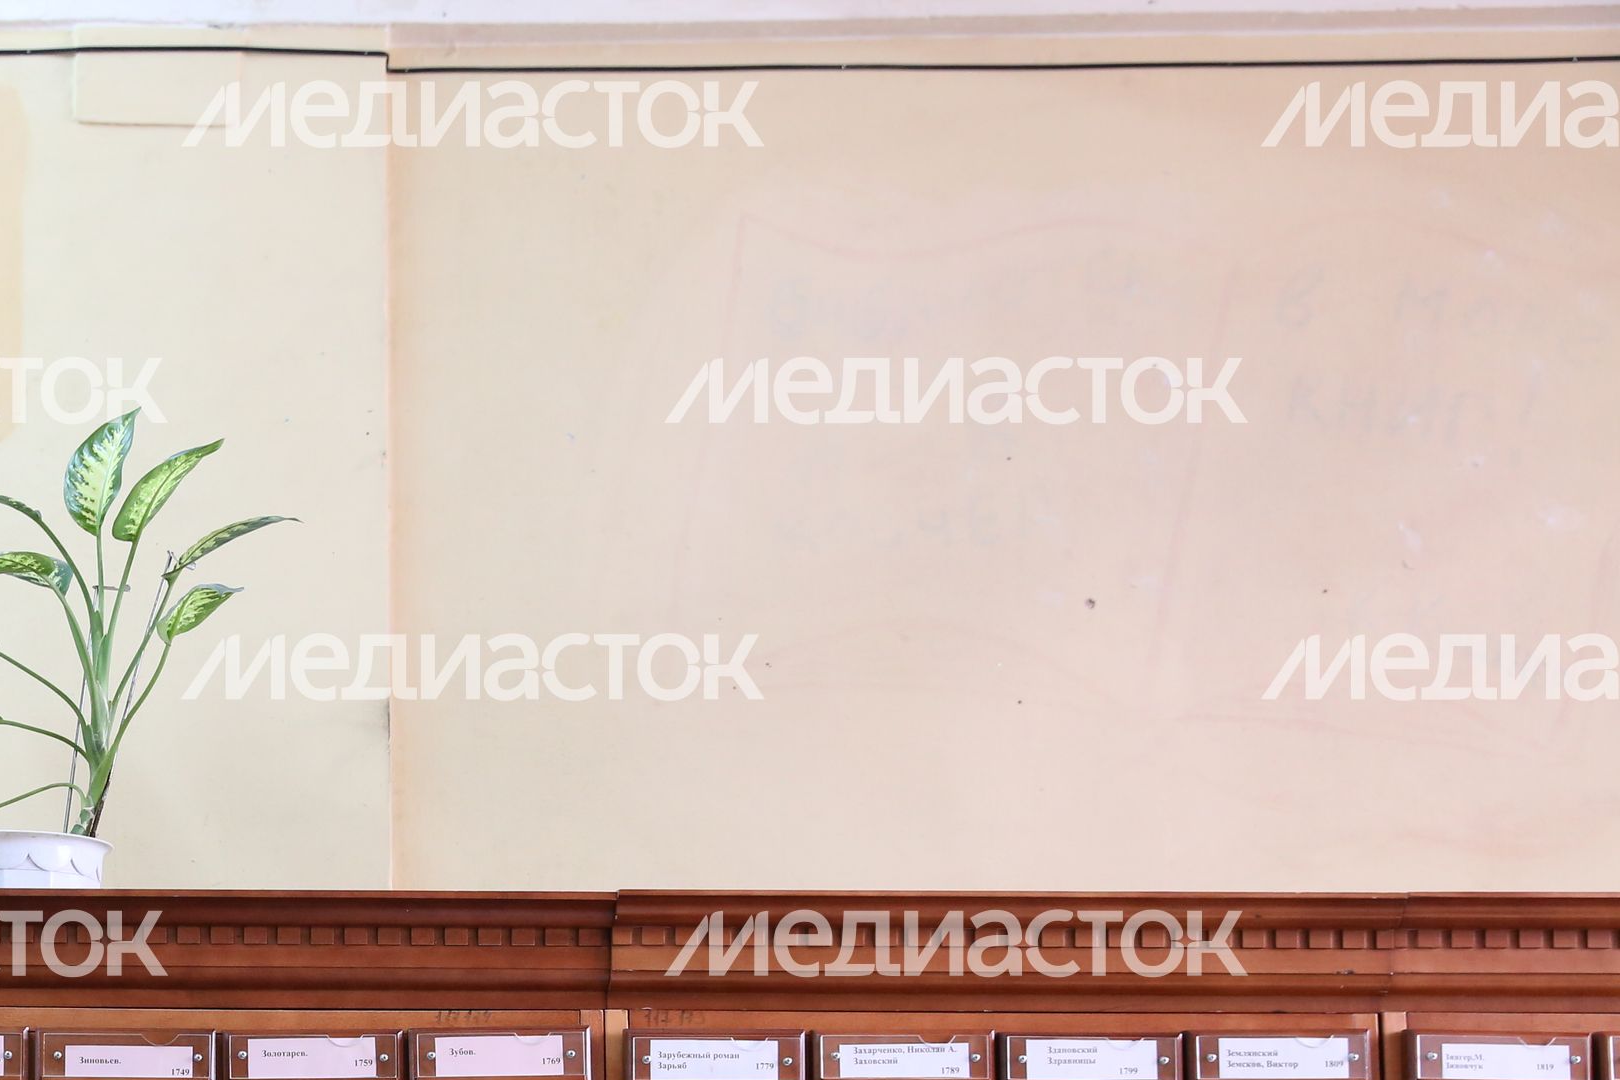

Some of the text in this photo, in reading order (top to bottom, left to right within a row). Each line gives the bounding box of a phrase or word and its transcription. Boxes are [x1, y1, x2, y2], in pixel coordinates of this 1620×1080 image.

[261, 1049, 308, 1059] Золотарев.
[449, 1048, 476, 1057] Зубов.
[658, 1051, 710, 1060] Зарубежный
[854, 1047, 905, 1056] Захарченко,
[79, 1056, 122, 1064] Зиновьев.
[354, 1059, 373, 1067] 1759
[542, 1057, 561, 1065] 1769
[756, 1062, 774, 1070] 1779
[1120, 1067, 1138, 1075] 1799
